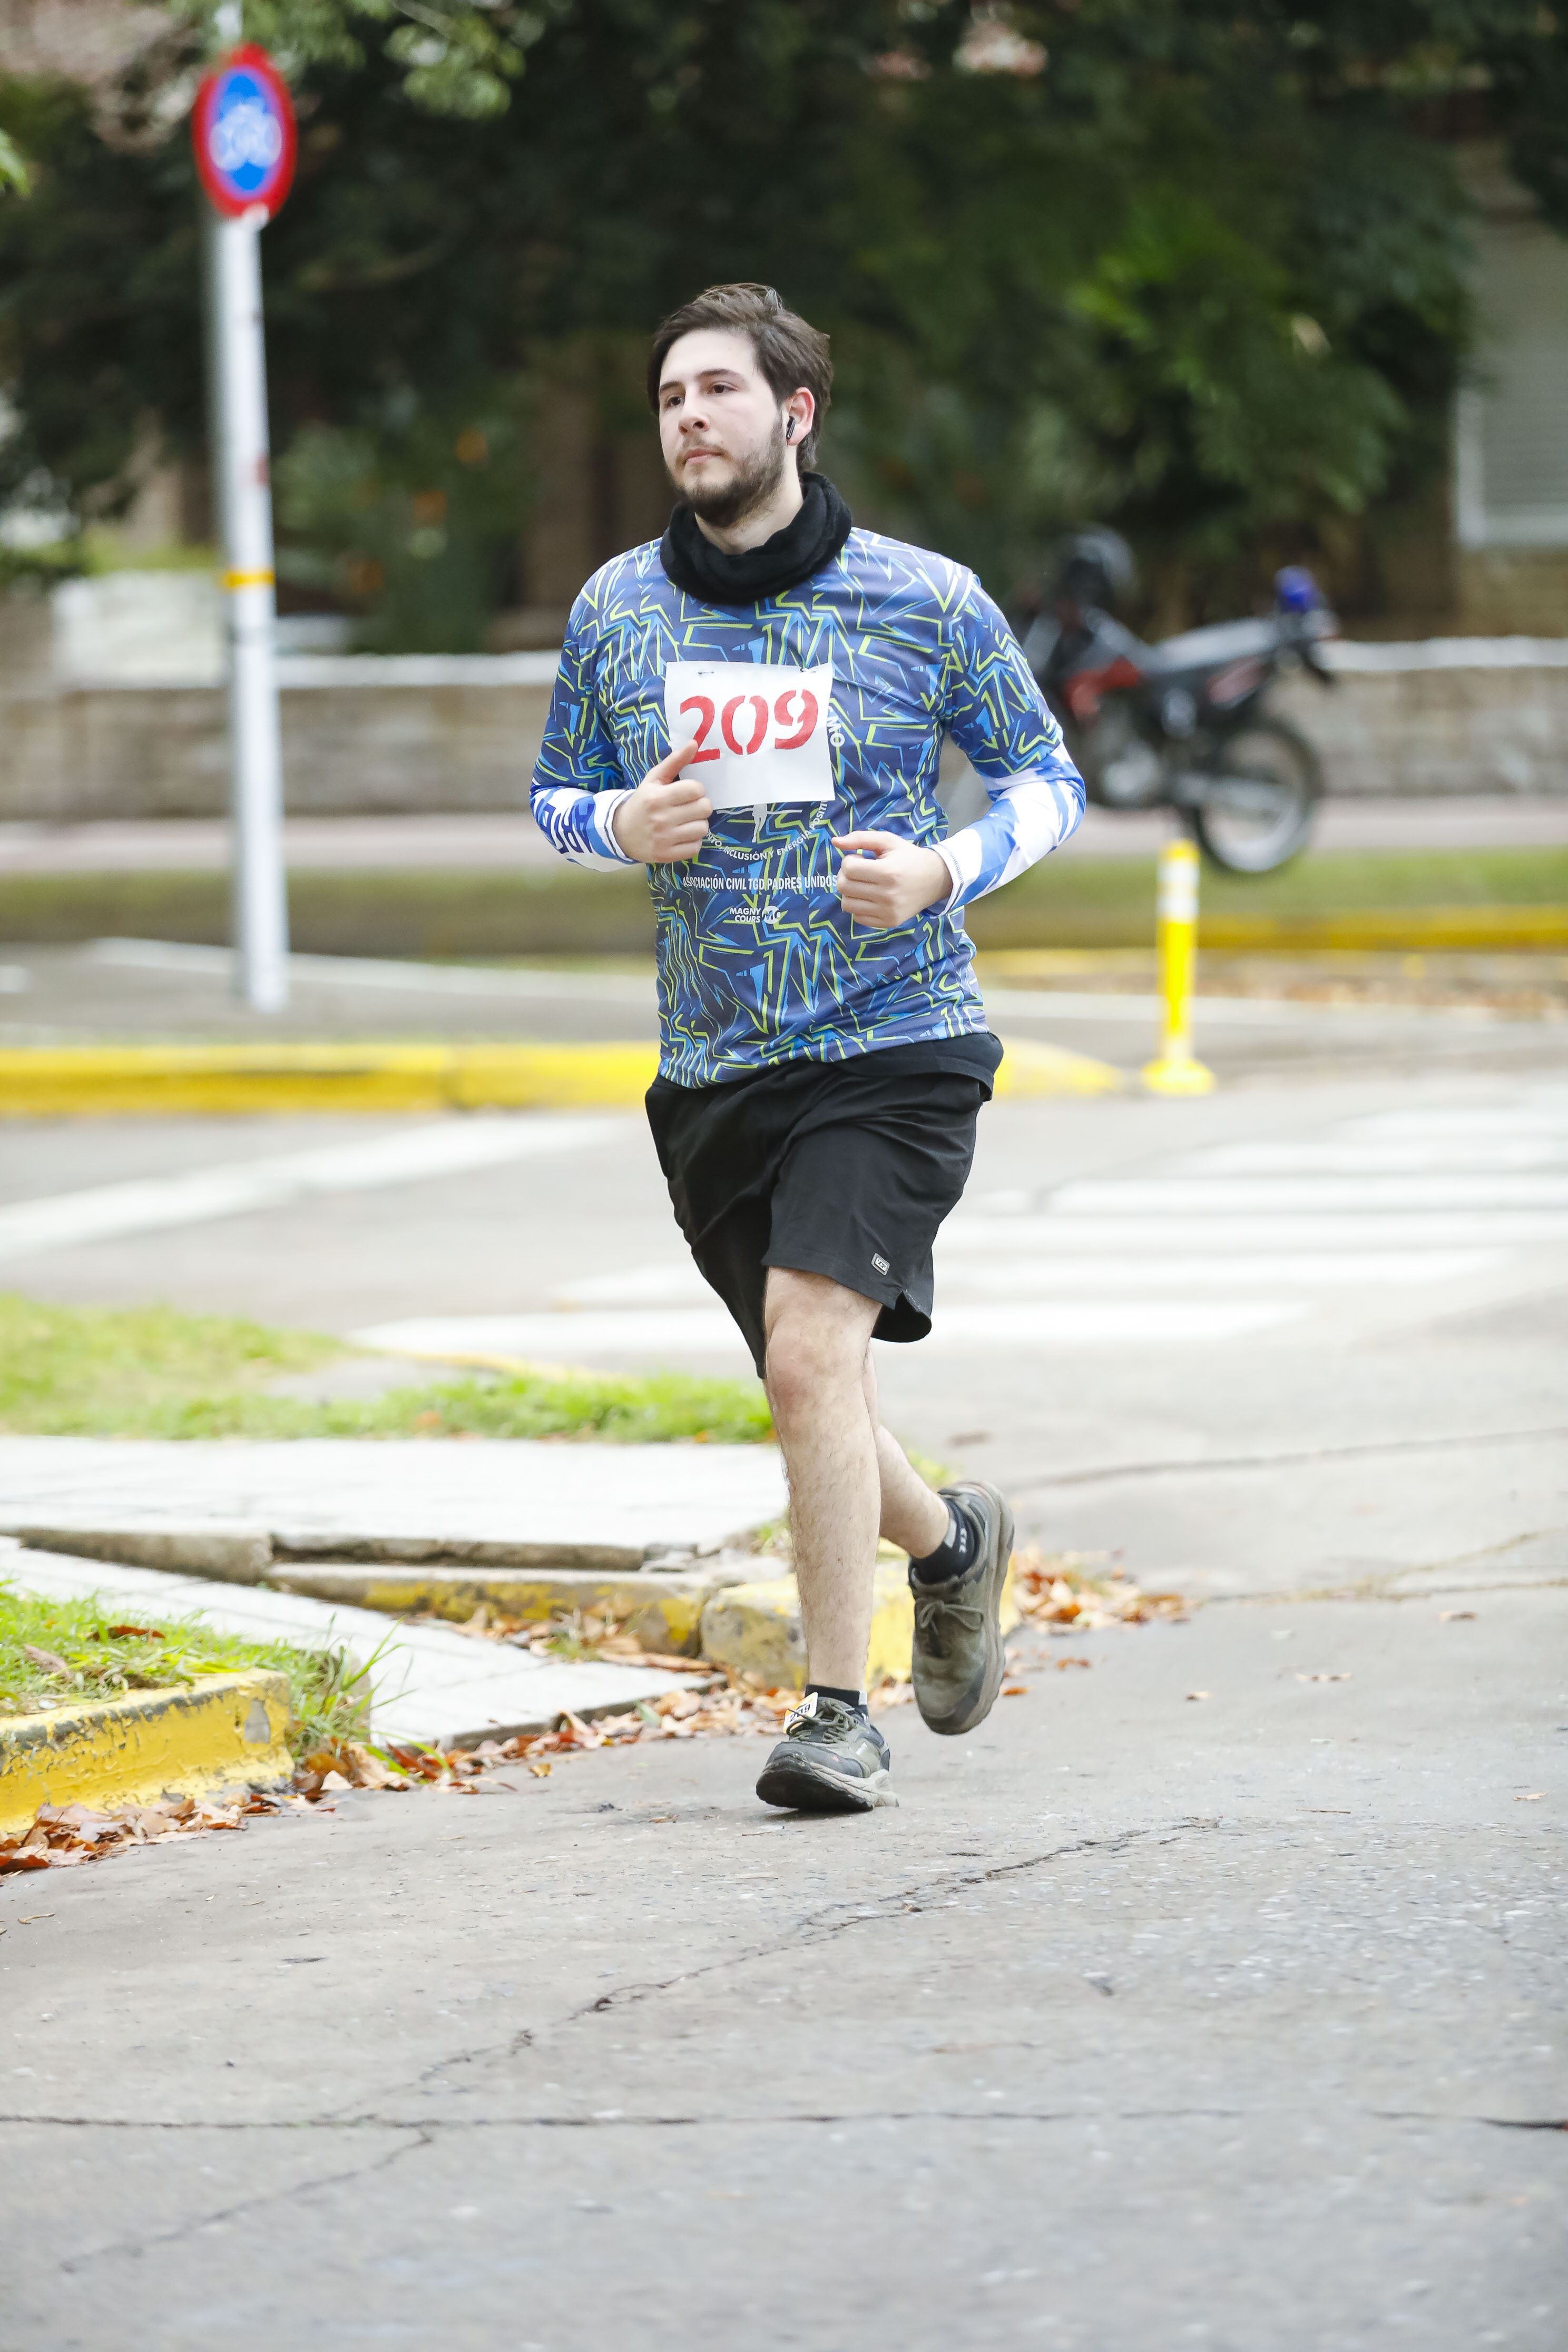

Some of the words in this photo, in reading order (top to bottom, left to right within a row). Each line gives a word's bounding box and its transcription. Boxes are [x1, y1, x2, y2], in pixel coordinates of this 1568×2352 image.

[680, 689, 818, 764] 209
[723, 846, 767, 860] INCLUSIÓN
[683, 874, 723, 889] ASOCIACIÓN
[726, 878, 747, 890] CIVIL
[748, 878, 764, 890] TGD
[767, 877, 801, 890] PADRES
[805, 875, 837, 888] UNIDOS
